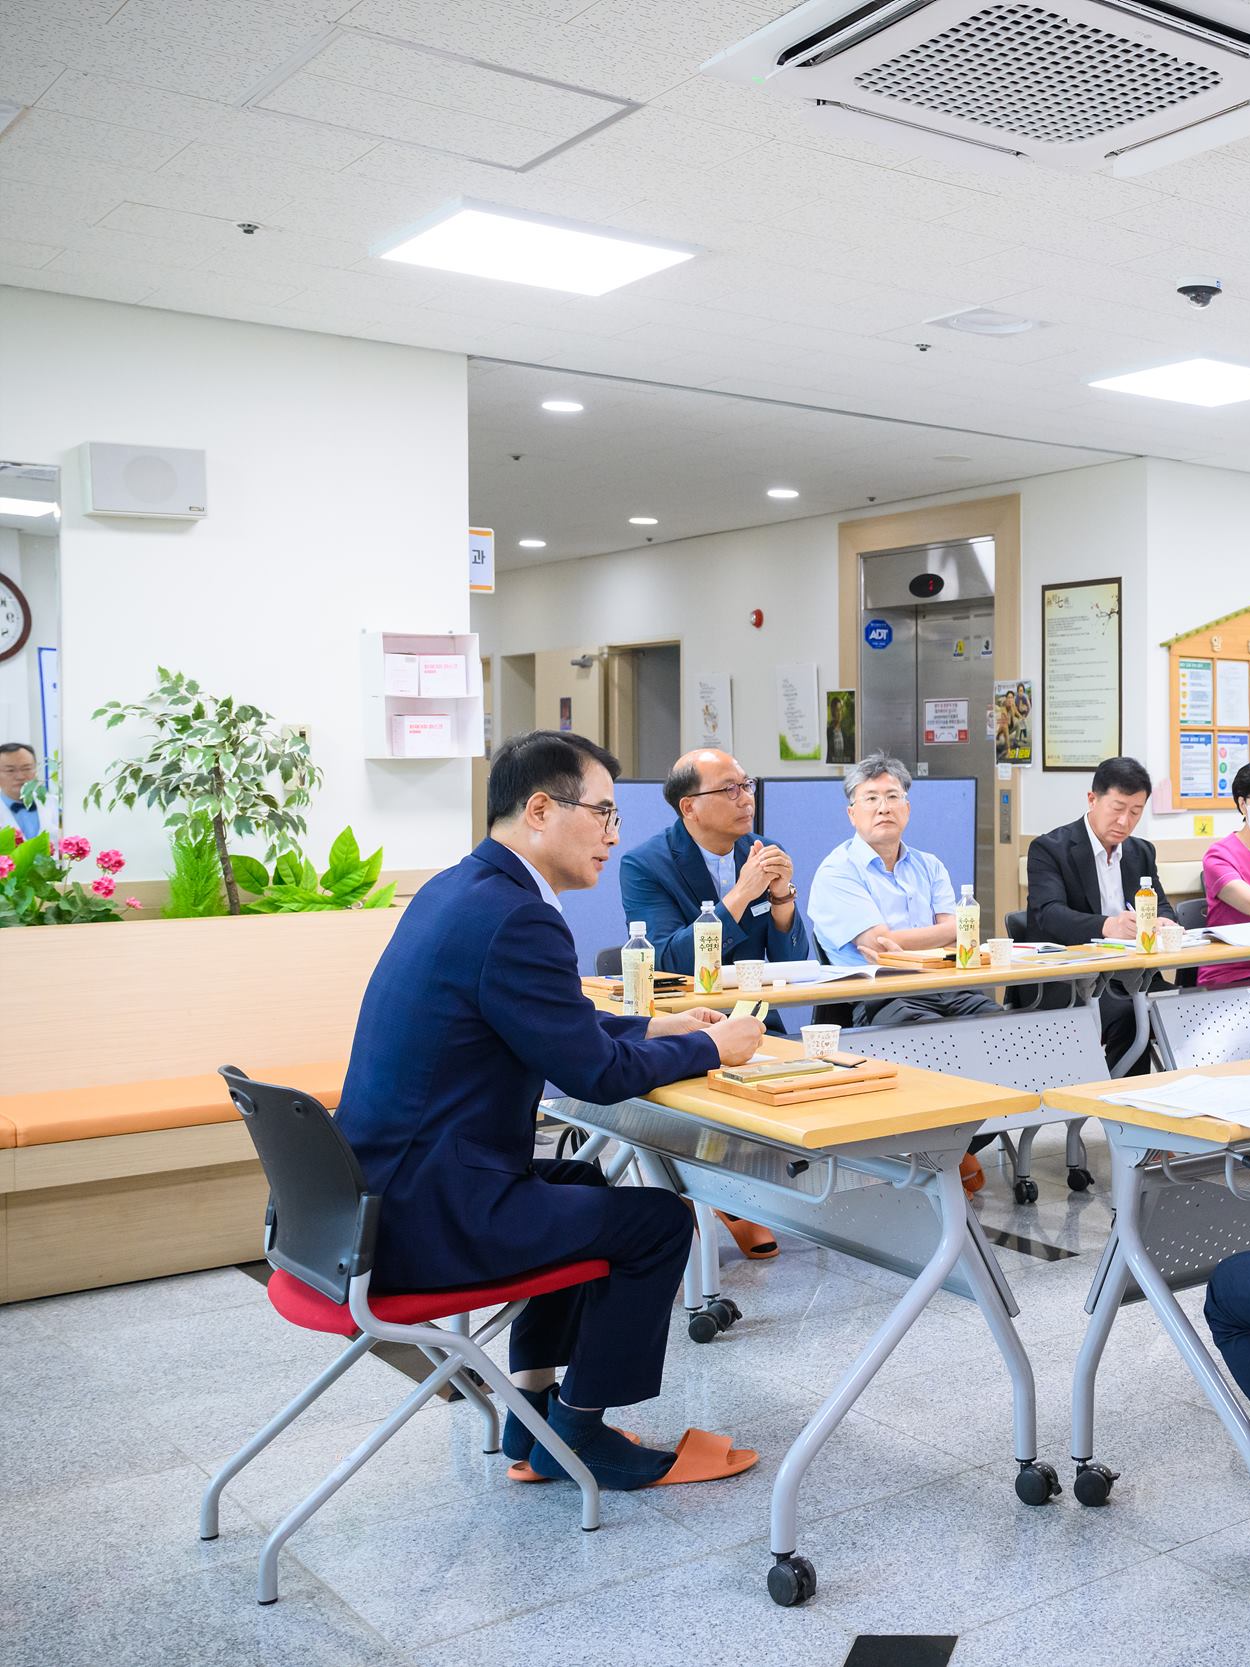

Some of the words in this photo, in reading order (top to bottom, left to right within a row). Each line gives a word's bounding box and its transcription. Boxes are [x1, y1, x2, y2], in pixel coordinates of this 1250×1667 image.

[869, 629, 888, 640] ADT
[699, 936, 720, 944] 옥수수
[699, 943, 720, 951] 수염차
